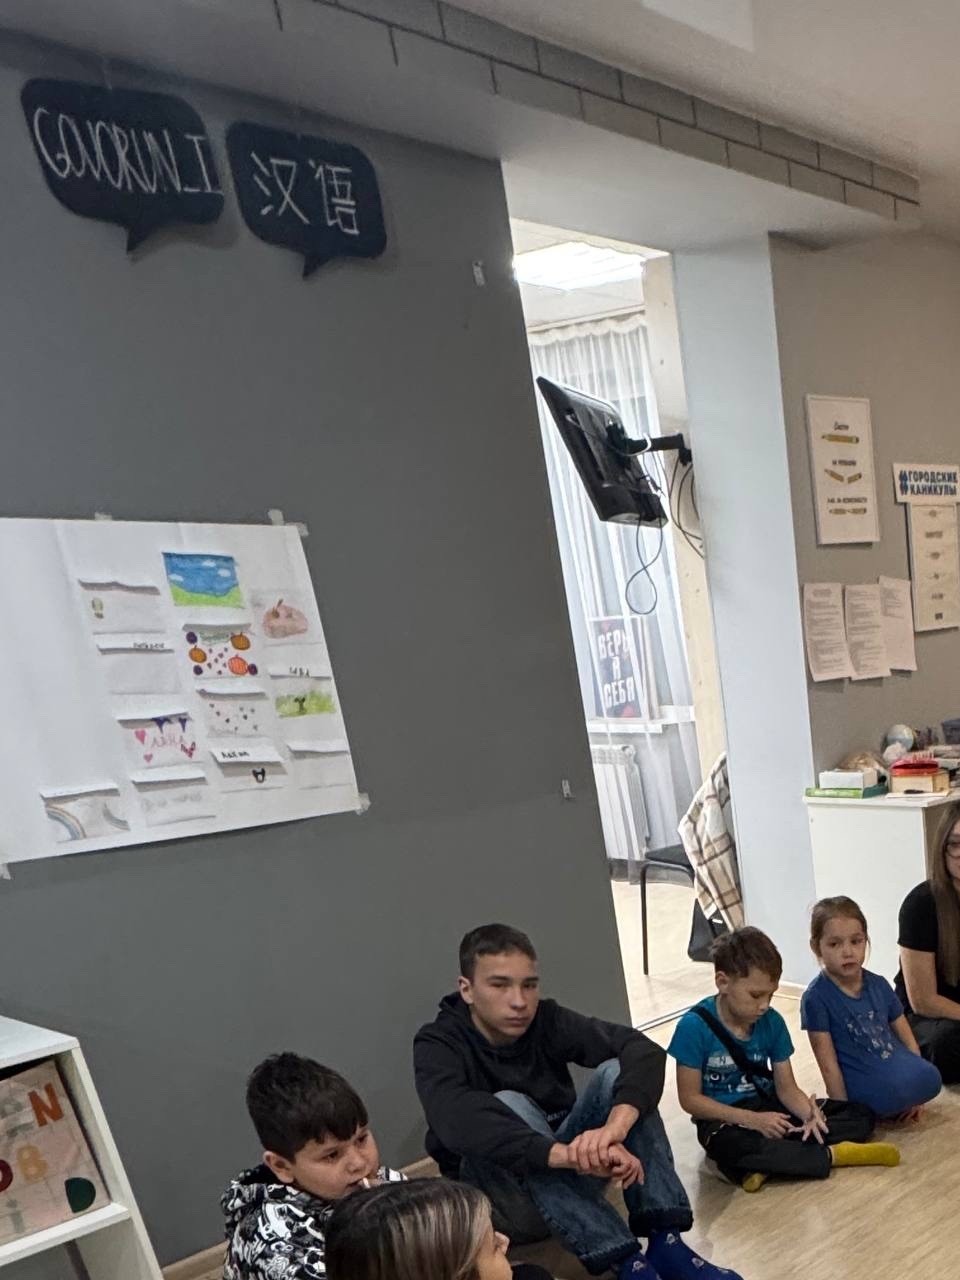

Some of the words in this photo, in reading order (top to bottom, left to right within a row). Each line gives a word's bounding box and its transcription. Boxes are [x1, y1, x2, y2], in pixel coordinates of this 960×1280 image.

[908, 470, 958, 484] ГОРОДСКИЕ
[909, 484, 958, 497] КАНИКУЛЫ
[603, 676, 636, 709] СЕБЯ
